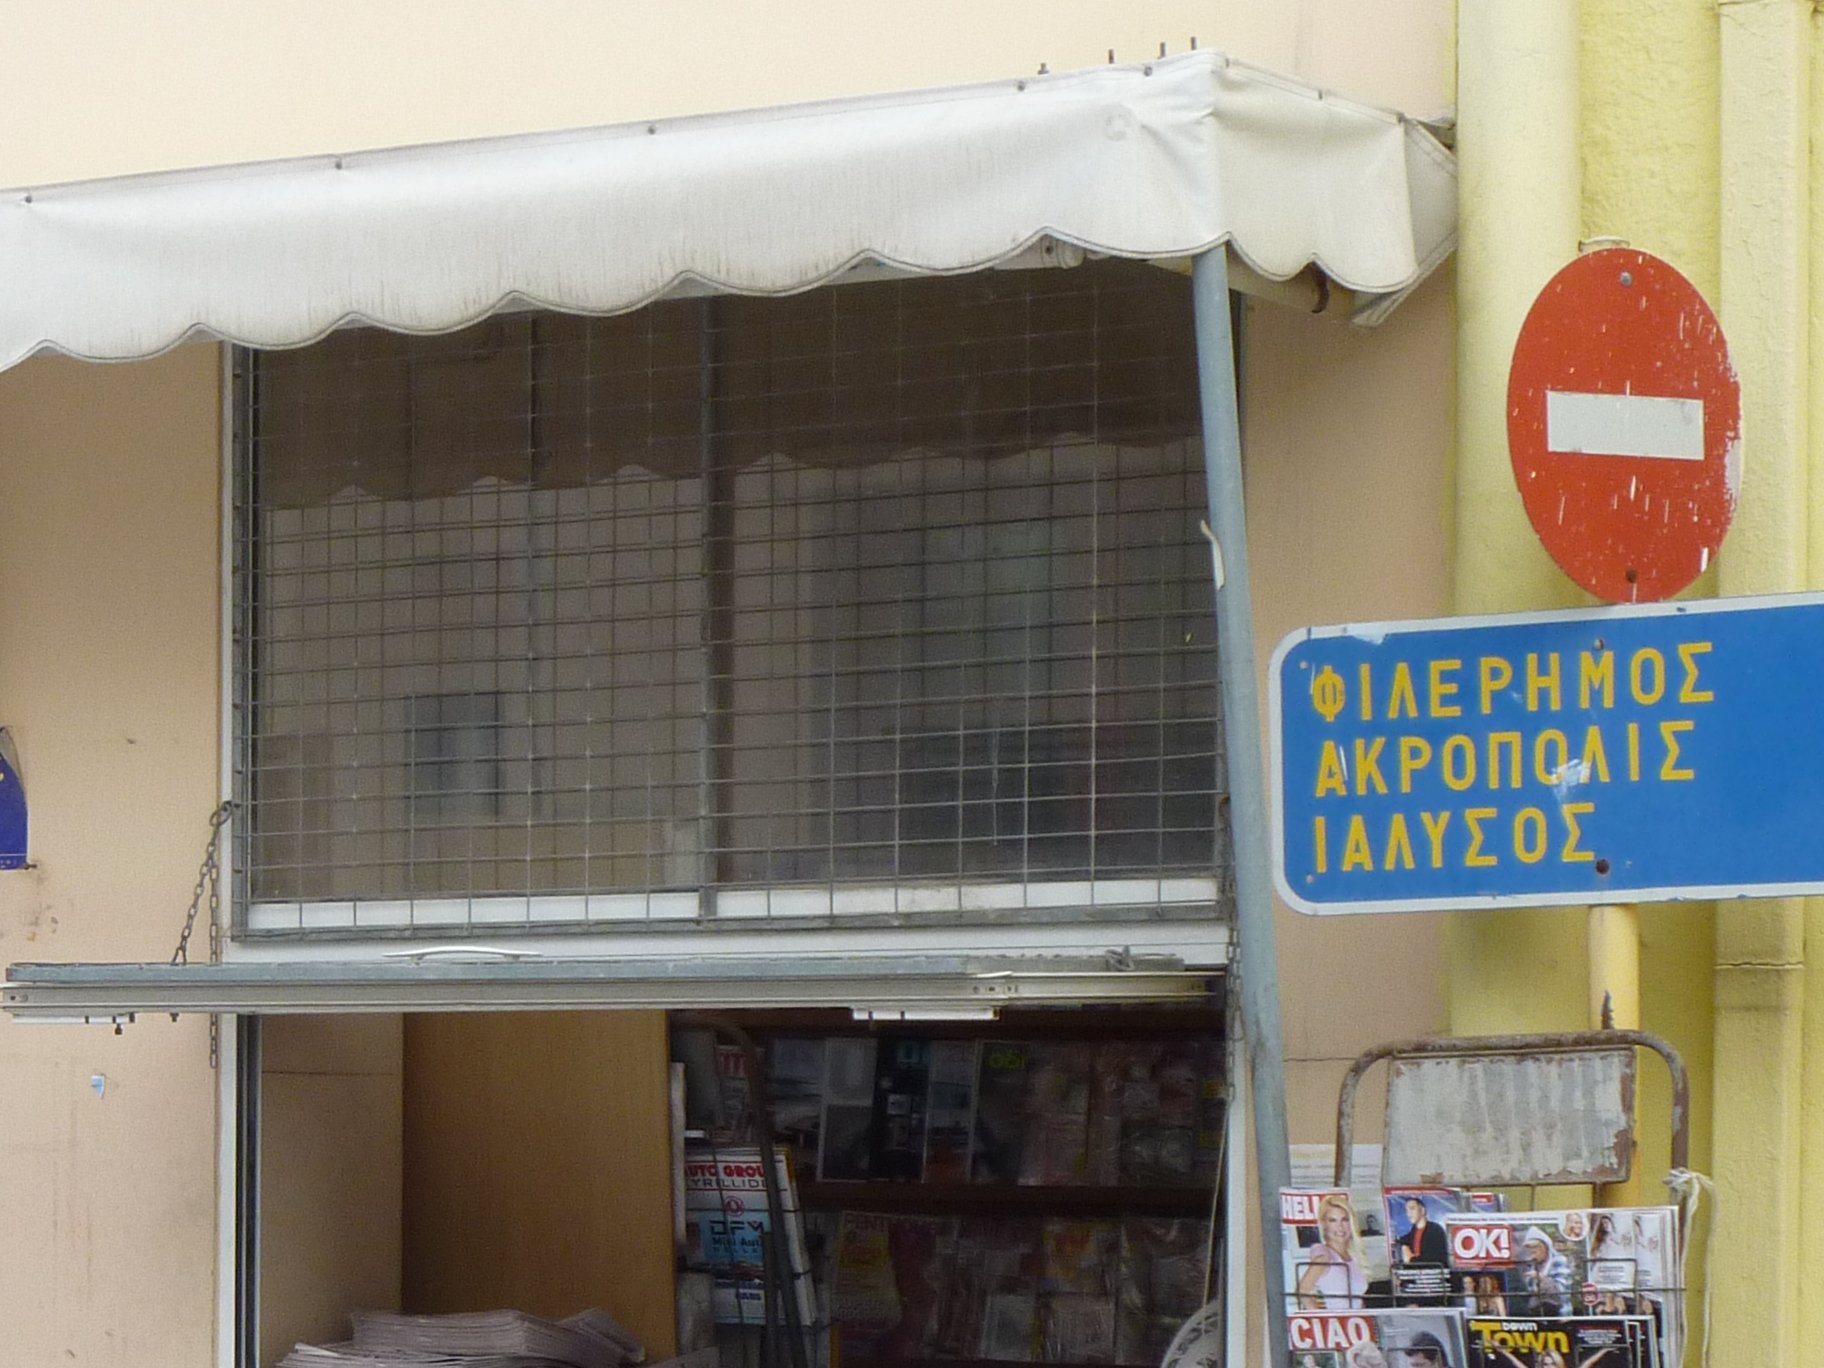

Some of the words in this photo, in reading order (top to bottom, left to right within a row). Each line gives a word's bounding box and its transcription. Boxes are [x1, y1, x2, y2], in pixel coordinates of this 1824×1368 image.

[1313, 642, 1714, 721] ΦΙΛΕΡΗΜΟΣ
[1315, 721, 1695, 796] ΑΚΡΟΠΟΛΙΣ
[1315, 803, 1595, 872] ΙΑΛΥΣΟΣ
[1453, 1229, 1510, 1259] OK!
[1291, 1318, 1372, 1347] CIAO
